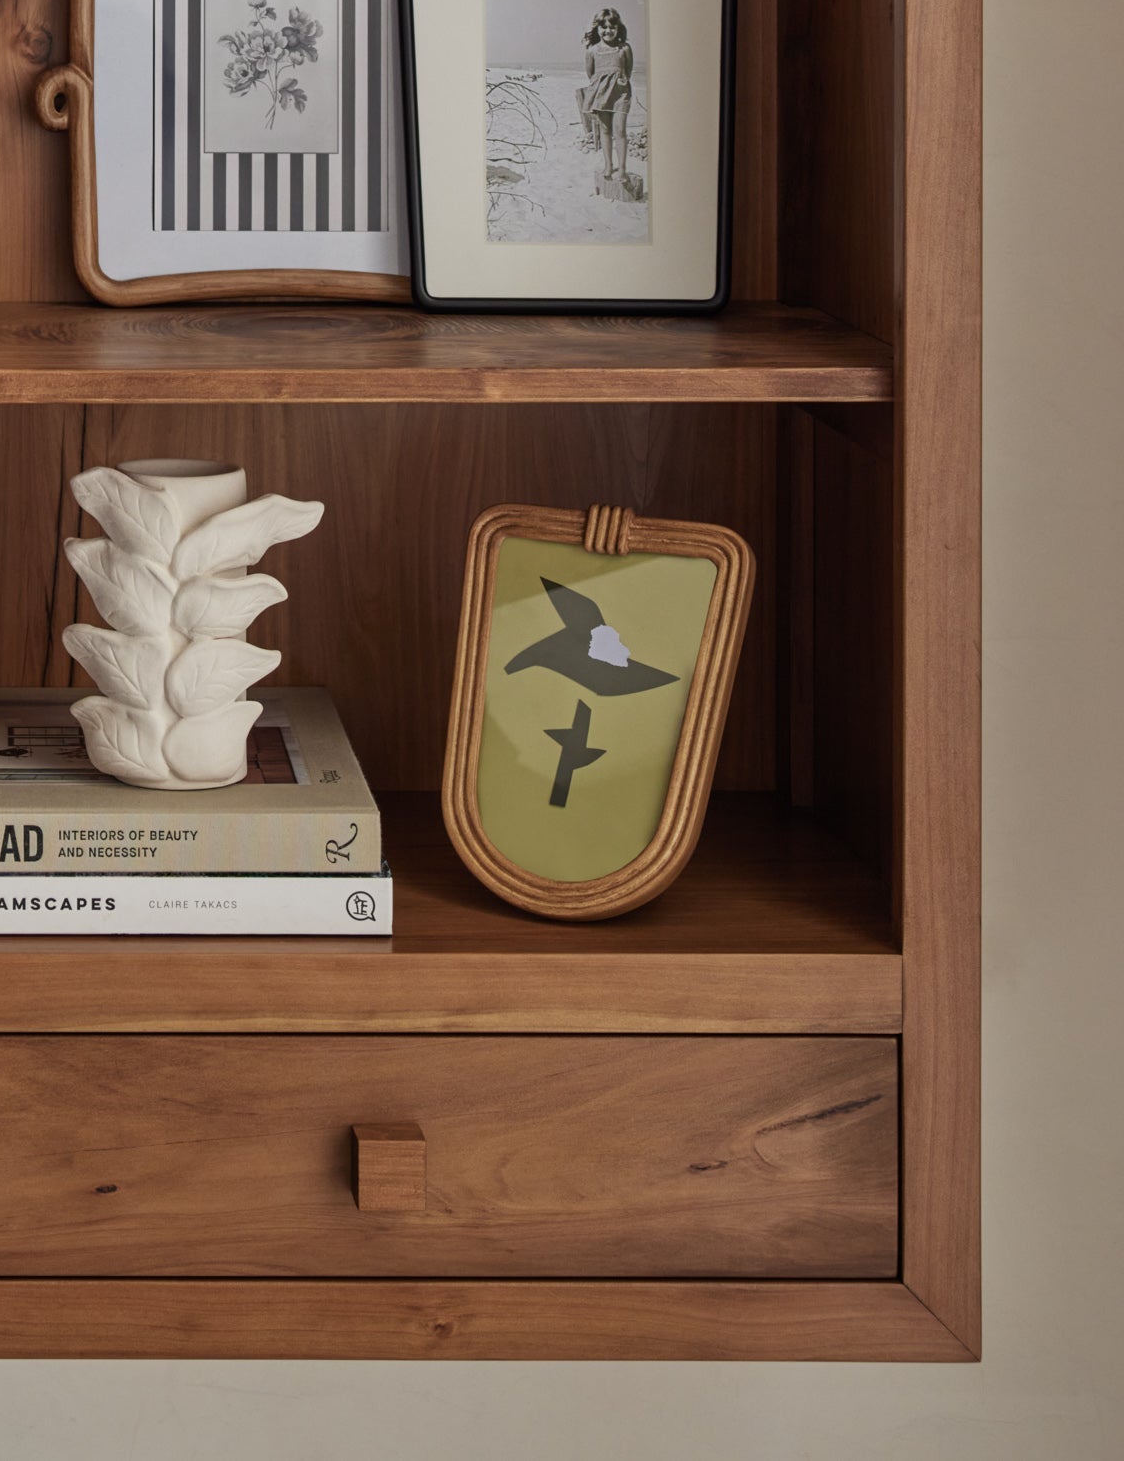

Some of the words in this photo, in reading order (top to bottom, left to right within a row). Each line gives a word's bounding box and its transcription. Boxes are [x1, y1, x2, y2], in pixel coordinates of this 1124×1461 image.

[57, 829, 125, 841] INTERIORS
[128, 829, 146, 841] OF
[149, 829, 199, 841] BEAUTY
[57, 846, 85, 858] AND
[88, 846, 158, 858] NECESSITY
[148, 899, 190, 910] CLAIRE
[193, 899, 239, 910] TAKACS
